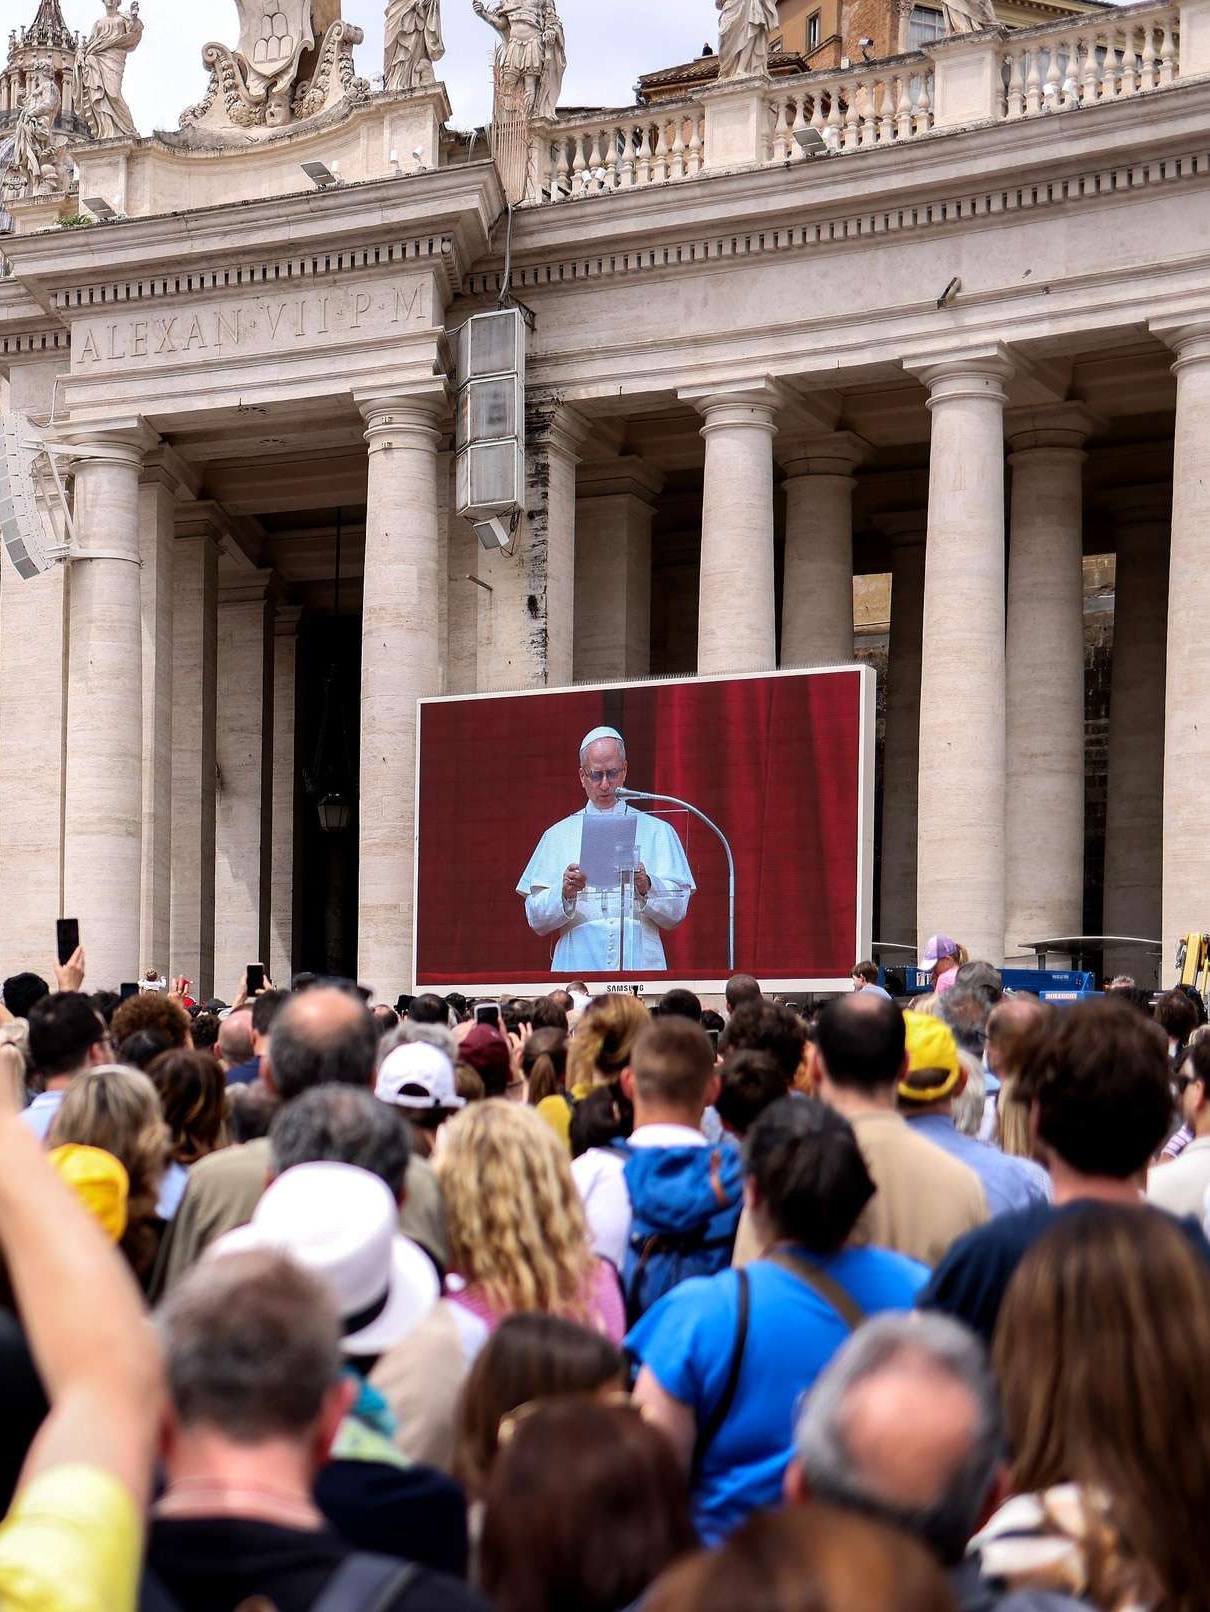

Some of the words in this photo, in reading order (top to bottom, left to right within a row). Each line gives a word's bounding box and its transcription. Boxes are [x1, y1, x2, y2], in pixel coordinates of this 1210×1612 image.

[76, 308, 243, 364] ALEXAN
[260, 297, 329, 340] VII
[350, 291, 372, 329] P
[391, 283, 427, 323] M
[606, 984, 644, 992] SAMSUG
